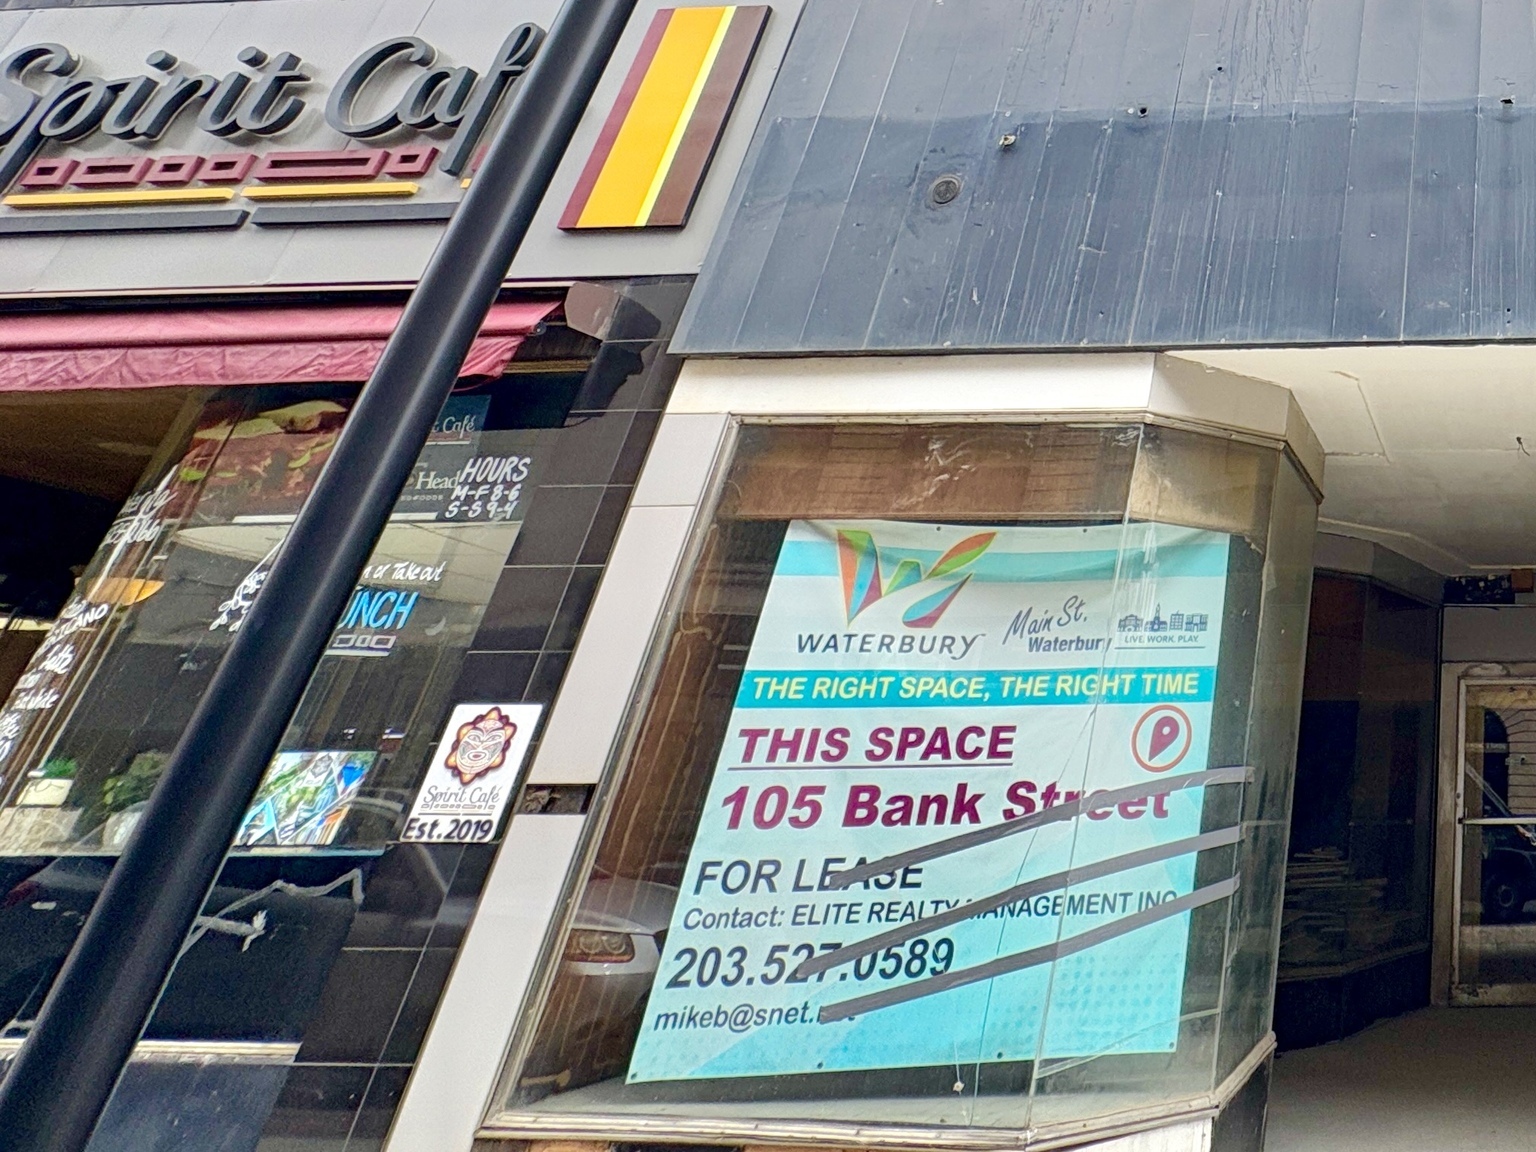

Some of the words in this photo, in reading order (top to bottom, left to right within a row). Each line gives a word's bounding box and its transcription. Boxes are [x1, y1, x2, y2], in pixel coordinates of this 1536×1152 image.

[0, 42, 312, 198] Spirit
[324, 21, 548, 177] Caf
[442, 415, 476, 439] Café
[415, 470, 461, 490] Head
[459, 456, 531, 483] HOURS
[450, 484, 490, 501] M-F
[490, 484, 522, 502] 8-6
[445, 501, 483, 519] S-S
[486, 501, 518, 519] 9-4
[337, 591, 420, 630] UNCH
[1002, 606, 1053, 645] Main
[1057, 595, 1088, 627] St.
[797, 633, 986, 660] WATERBURY
[1028, 635, 1113, 653] Waterbury
[1124, 635, 1146, 644] LIVE.
[1147, 634, 1177, 644] WORK.
[1177, 634, 1200, 643] PLAY.
[753, 676, 808, 700] THE
[812, 676, 896, 699] RIGHT
[899, 676, 990, 702] SPACE,
[1000, 675, 1049, 698] THE
[1055, 673, 1136, 697] RIGHT
[1142, 672, 1200, 695] TIME
[738, 727, 851, 764] THIS
[864, 724, 1018, 762] SPACE
[423, 785, 467, 810] Spirit
[469, 785, 503, 810] Café
[720, 784, 828, 831] 105
[842, 782, 986, 828] Bank
[693, 859, 782, 895] FOR
[683, 905, 785, 930] Contact:
[790, 902, 863, 926] ELITE
[966, 891, 1134, 920] ANAGEMENT
[665, 938, 954, 989] 203.527.0589
[654, 1002, 856, 1033] mikeb@snet.
